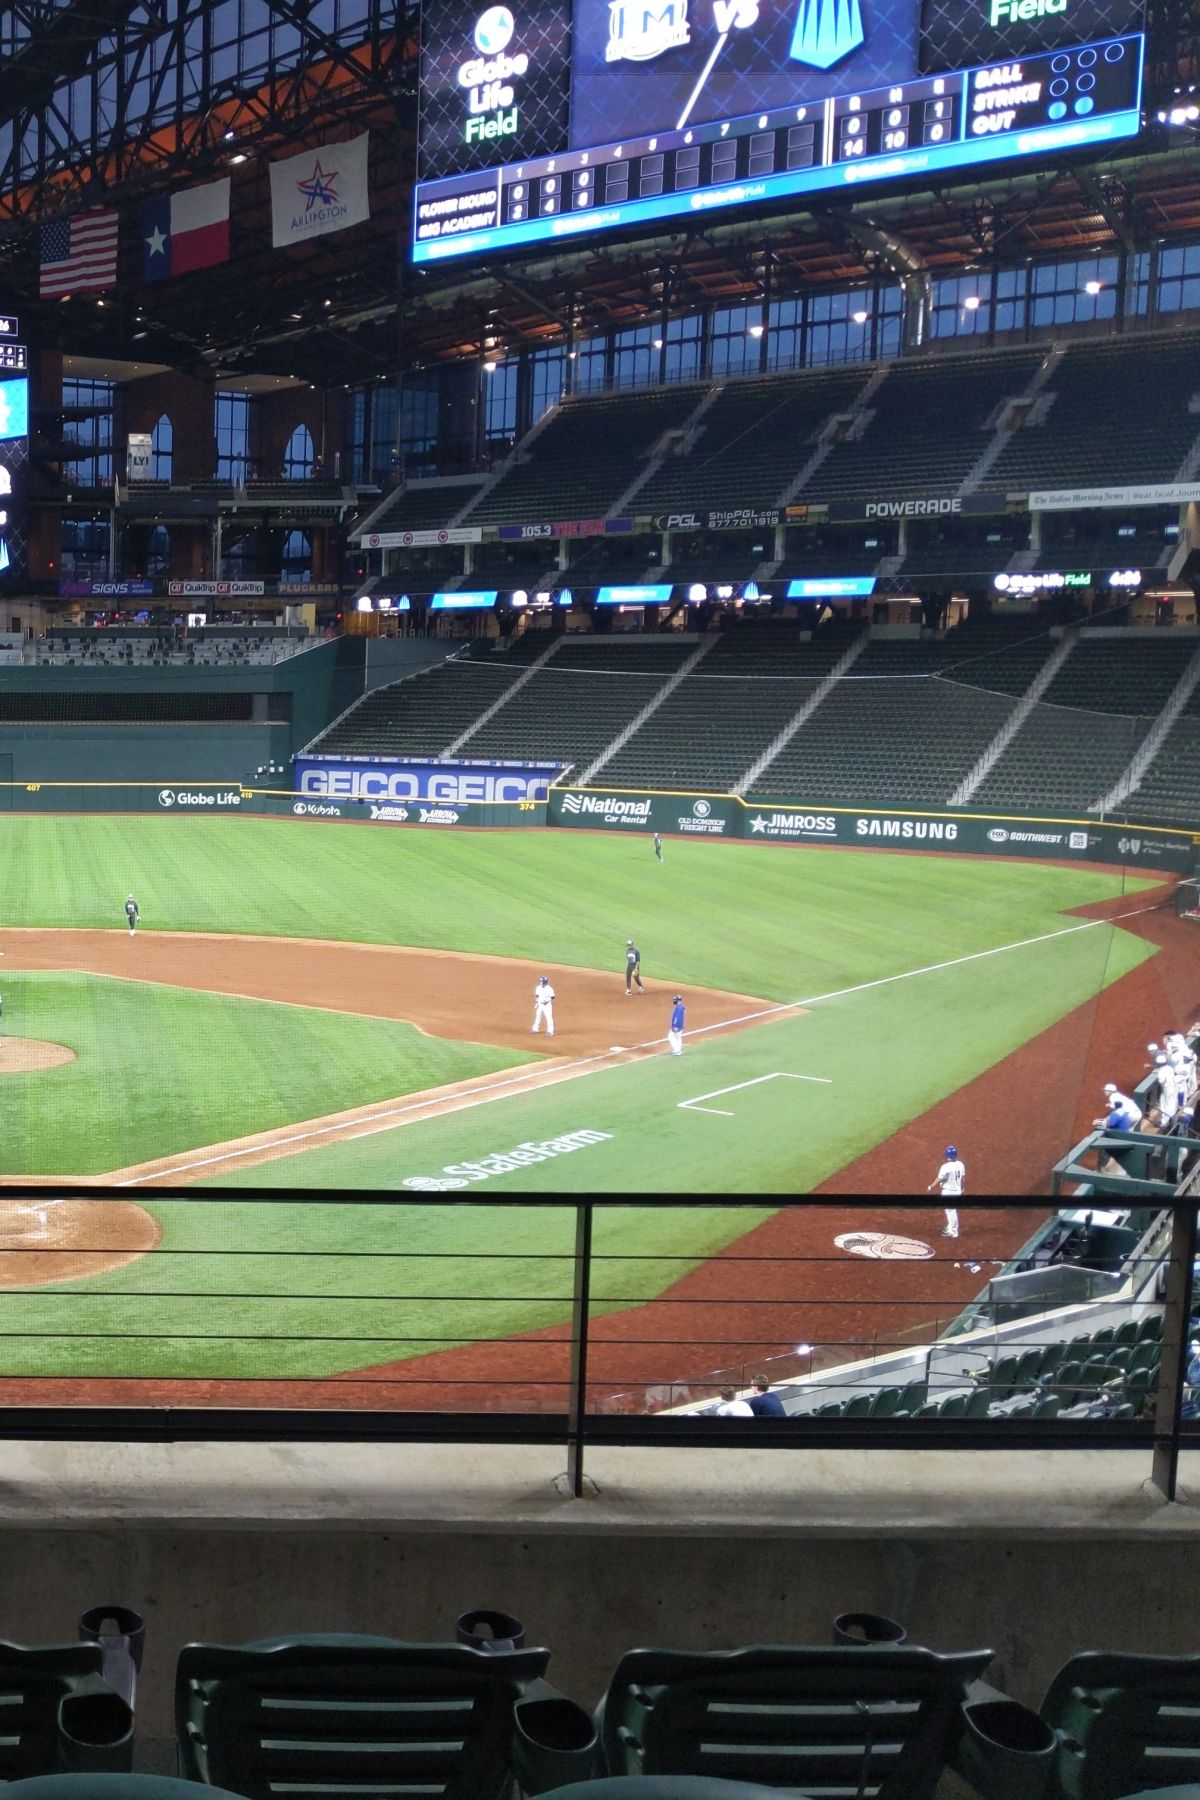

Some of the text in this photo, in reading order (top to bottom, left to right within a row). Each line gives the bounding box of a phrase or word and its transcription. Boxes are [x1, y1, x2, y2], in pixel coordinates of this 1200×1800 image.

[458, 52, 528, 88] Globe
[974, 64, 1023, 89] BALL
[470, 81, 514, 113] Life
[973, 82, 1042, 112] STRIKE
[465, 108, 518, 143] Field
[972, 110, 1016, 135] OUT
[516, 167, 523, 178] 1
[547, 160, 555, 172] 2
[581, 153, 589, 165] 3
[613, 145, 622, 158] 4
[649, 139, 657, 151] 5
[684, 131, 693, 143] 6
[721, 123, 730, 136] 7
[758, 115, 768, 128] 8
[797, 108, 806, 121] 9
[419, 198, 458, 218] FLOWER
[513, 185, 524, 199] 0
[545, 179, 556, 193] 0
[578, 172, 589, 186] 0
[848, 117, 860, 134] 0
[889, 109, 901, 126] 0
[934, 101, 944, 117] 1
[441, 211, 496, 234] ACADEMY
[512, 205, 523, 219] 2
[544, 198, 554, 213] 4
[843, 139, 864, 157] 14
[885, 131, 906, 149] 10
[930, 124, 944, 141] 0
[291, 205, 347, 230] ARLINGTON
[709, 509, 779, 520] ShipPGL.com
[866, 498, 962, 517] POWERADE
[667, 514, 701, 527] PGL
[521, 525, 551, 537] 105.3
[1065, 573, 1091, 585] Field
[170, 583, 215, 593] QT QuikTrip
[217, 583, 262, 593] QT QuikTrip
[279, 584, 338, 592] PLUCKERS
[301, 769, 550, 805] GEICO GEICO
[177, 792, 240, 804] Globe Life
[308, 804, 341, 815] Kubota
[520, 803, 535, 811] 374
[605, 815, 647, 824] Car Rental
[692, 819, 725, 827] DOMINION
[680, 824, 706, 832] FREIGHT
[857, 819, 957, 840] SAMSUNG
[1010, 832, 1062, 843] SOUTHWEST
[442, 1129, 615, 1181] StateFarm
